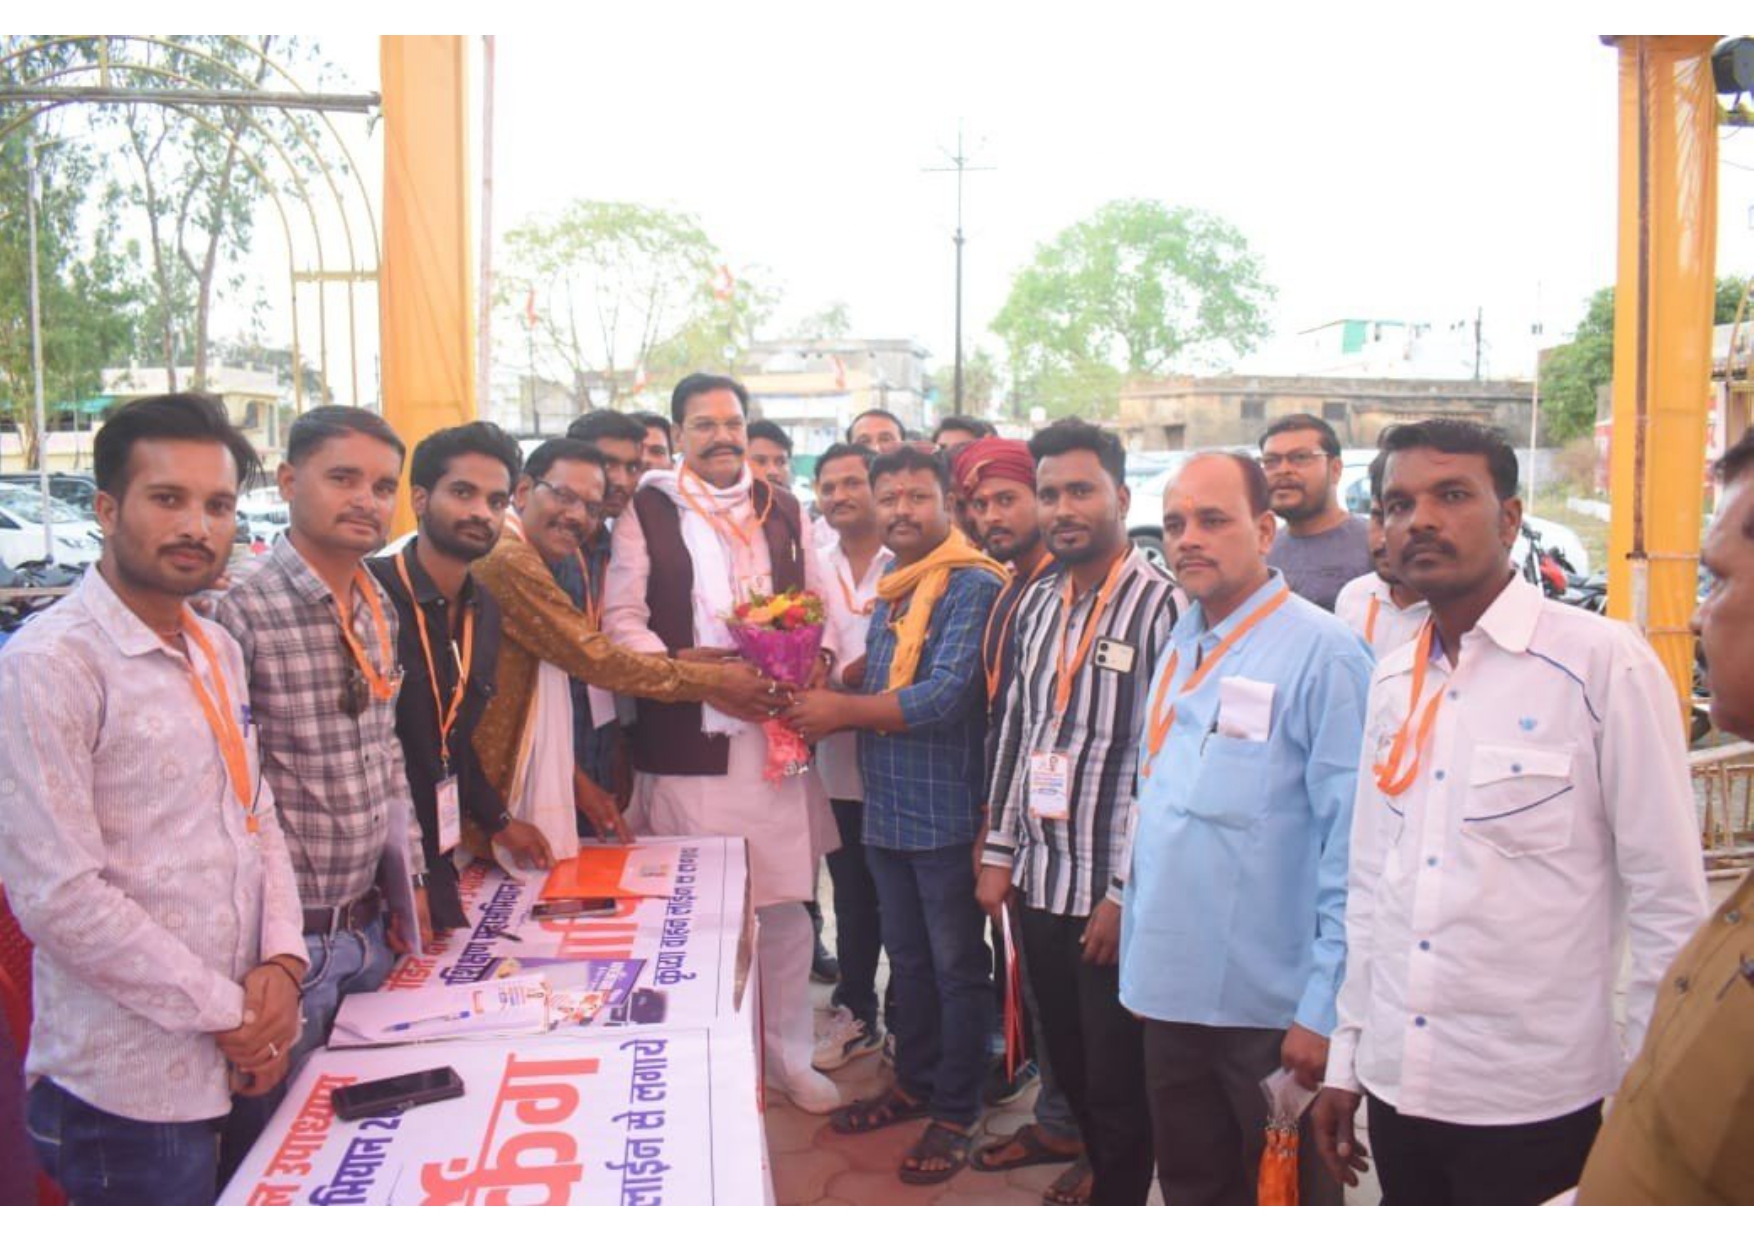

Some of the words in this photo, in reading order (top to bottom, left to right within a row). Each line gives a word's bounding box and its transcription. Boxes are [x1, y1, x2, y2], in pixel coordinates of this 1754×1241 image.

[619, 1038, 668, 1104] लगाये
[264, 1073, 358, 1177] उपाध्याय
[611, 1110, 666, 1132] से
[309, 1137, 393, 1206] भियान
